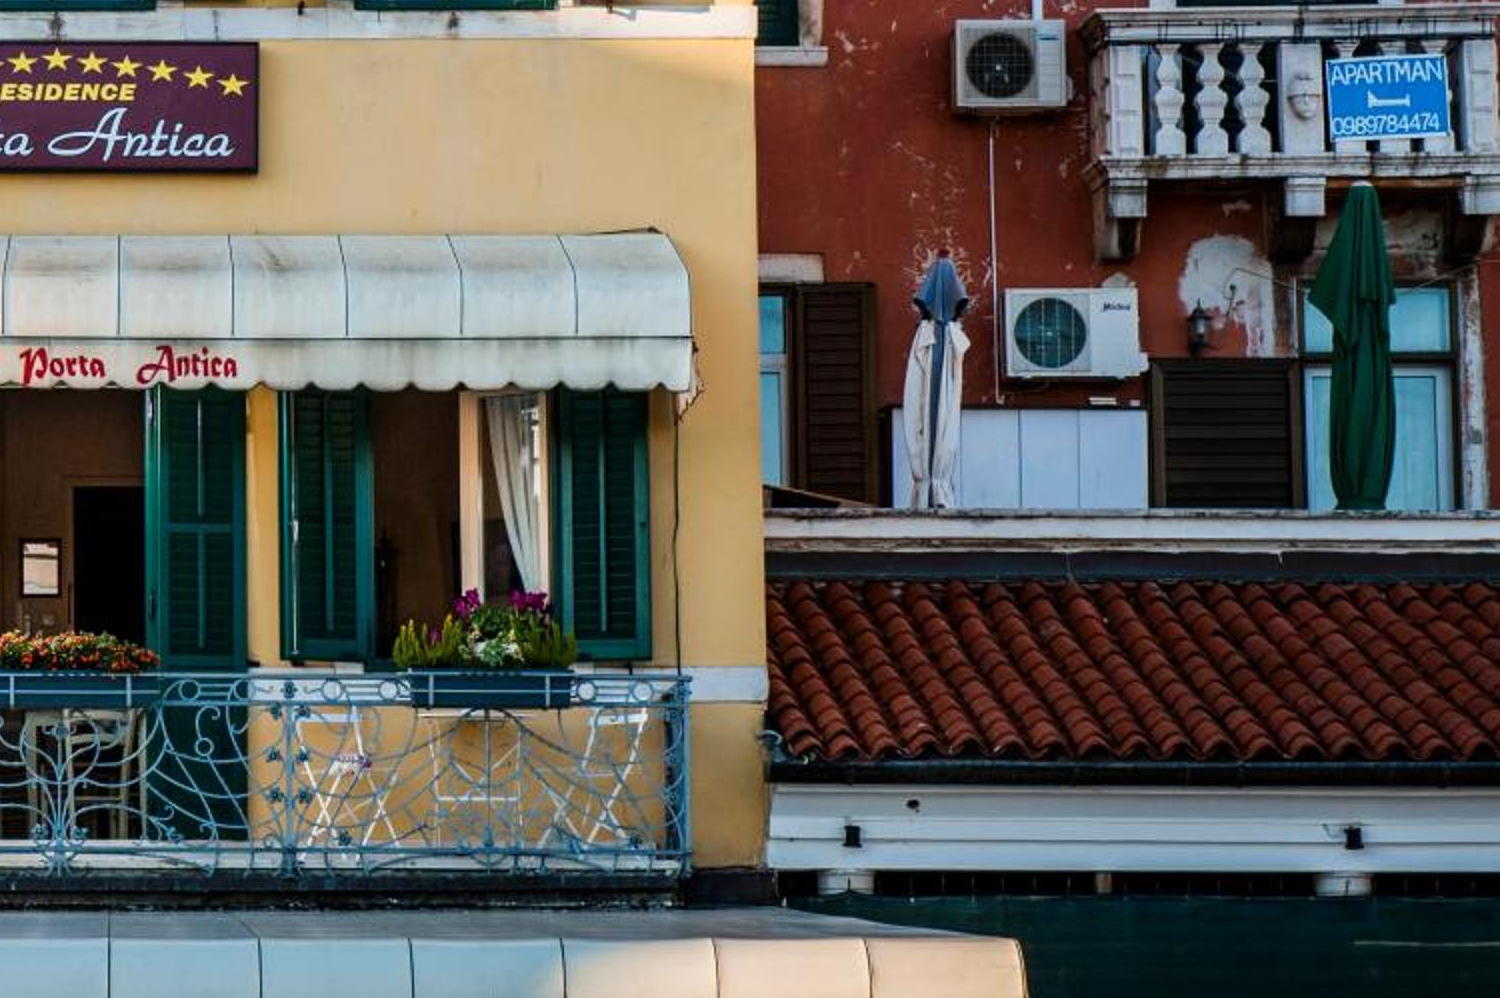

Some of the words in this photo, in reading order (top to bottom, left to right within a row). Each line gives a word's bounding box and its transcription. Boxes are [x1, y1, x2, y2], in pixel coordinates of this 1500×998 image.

[1331, 60, 1443, 86] APARTMAN
[47, 106, 234, 161] Antica
[1332, 113, 1439, 135] 0989784474
[19, 347, 106, 384] Porta
[136, 345, 237, 384] Antica
